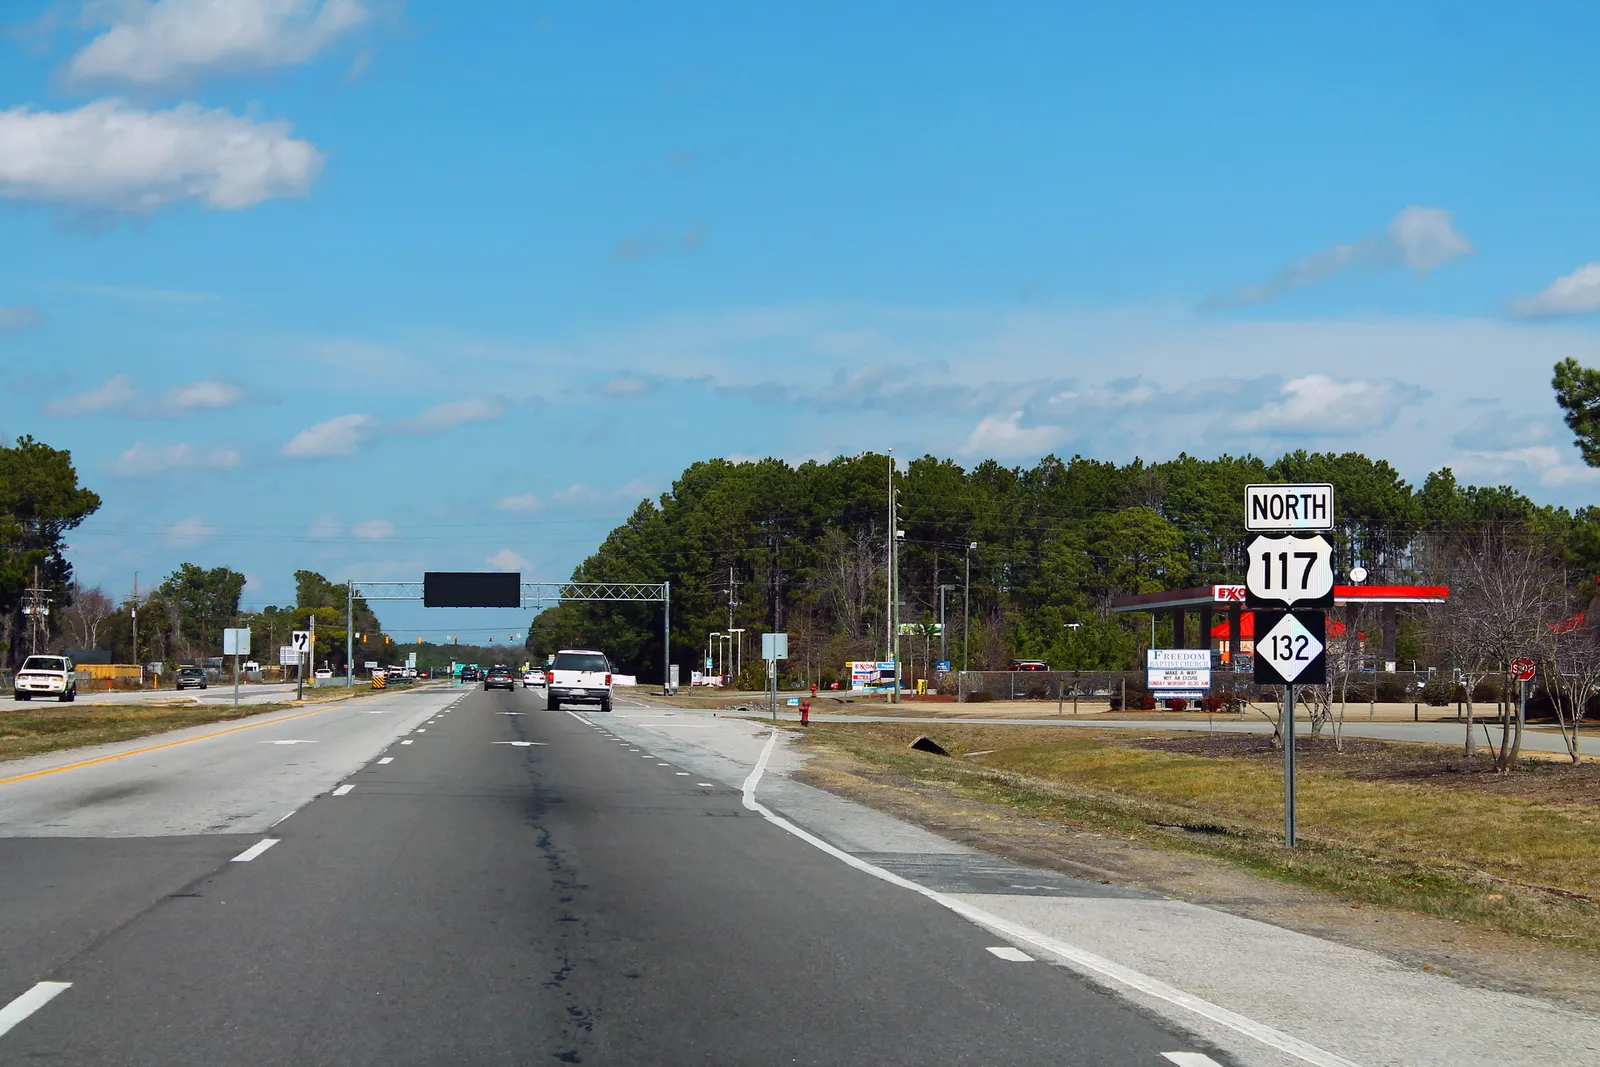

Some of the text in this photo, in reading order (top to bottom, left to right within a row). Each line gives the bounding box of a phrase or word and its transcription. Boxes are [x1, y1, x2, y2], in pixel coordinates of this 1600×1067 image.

[1252, 494, 1326, 520] NORTH
[1262, 552, 1318, 590] 117
[1153, 651, 1205, 660] FREEDOM
[1272, 635, 1309, 661] 132
